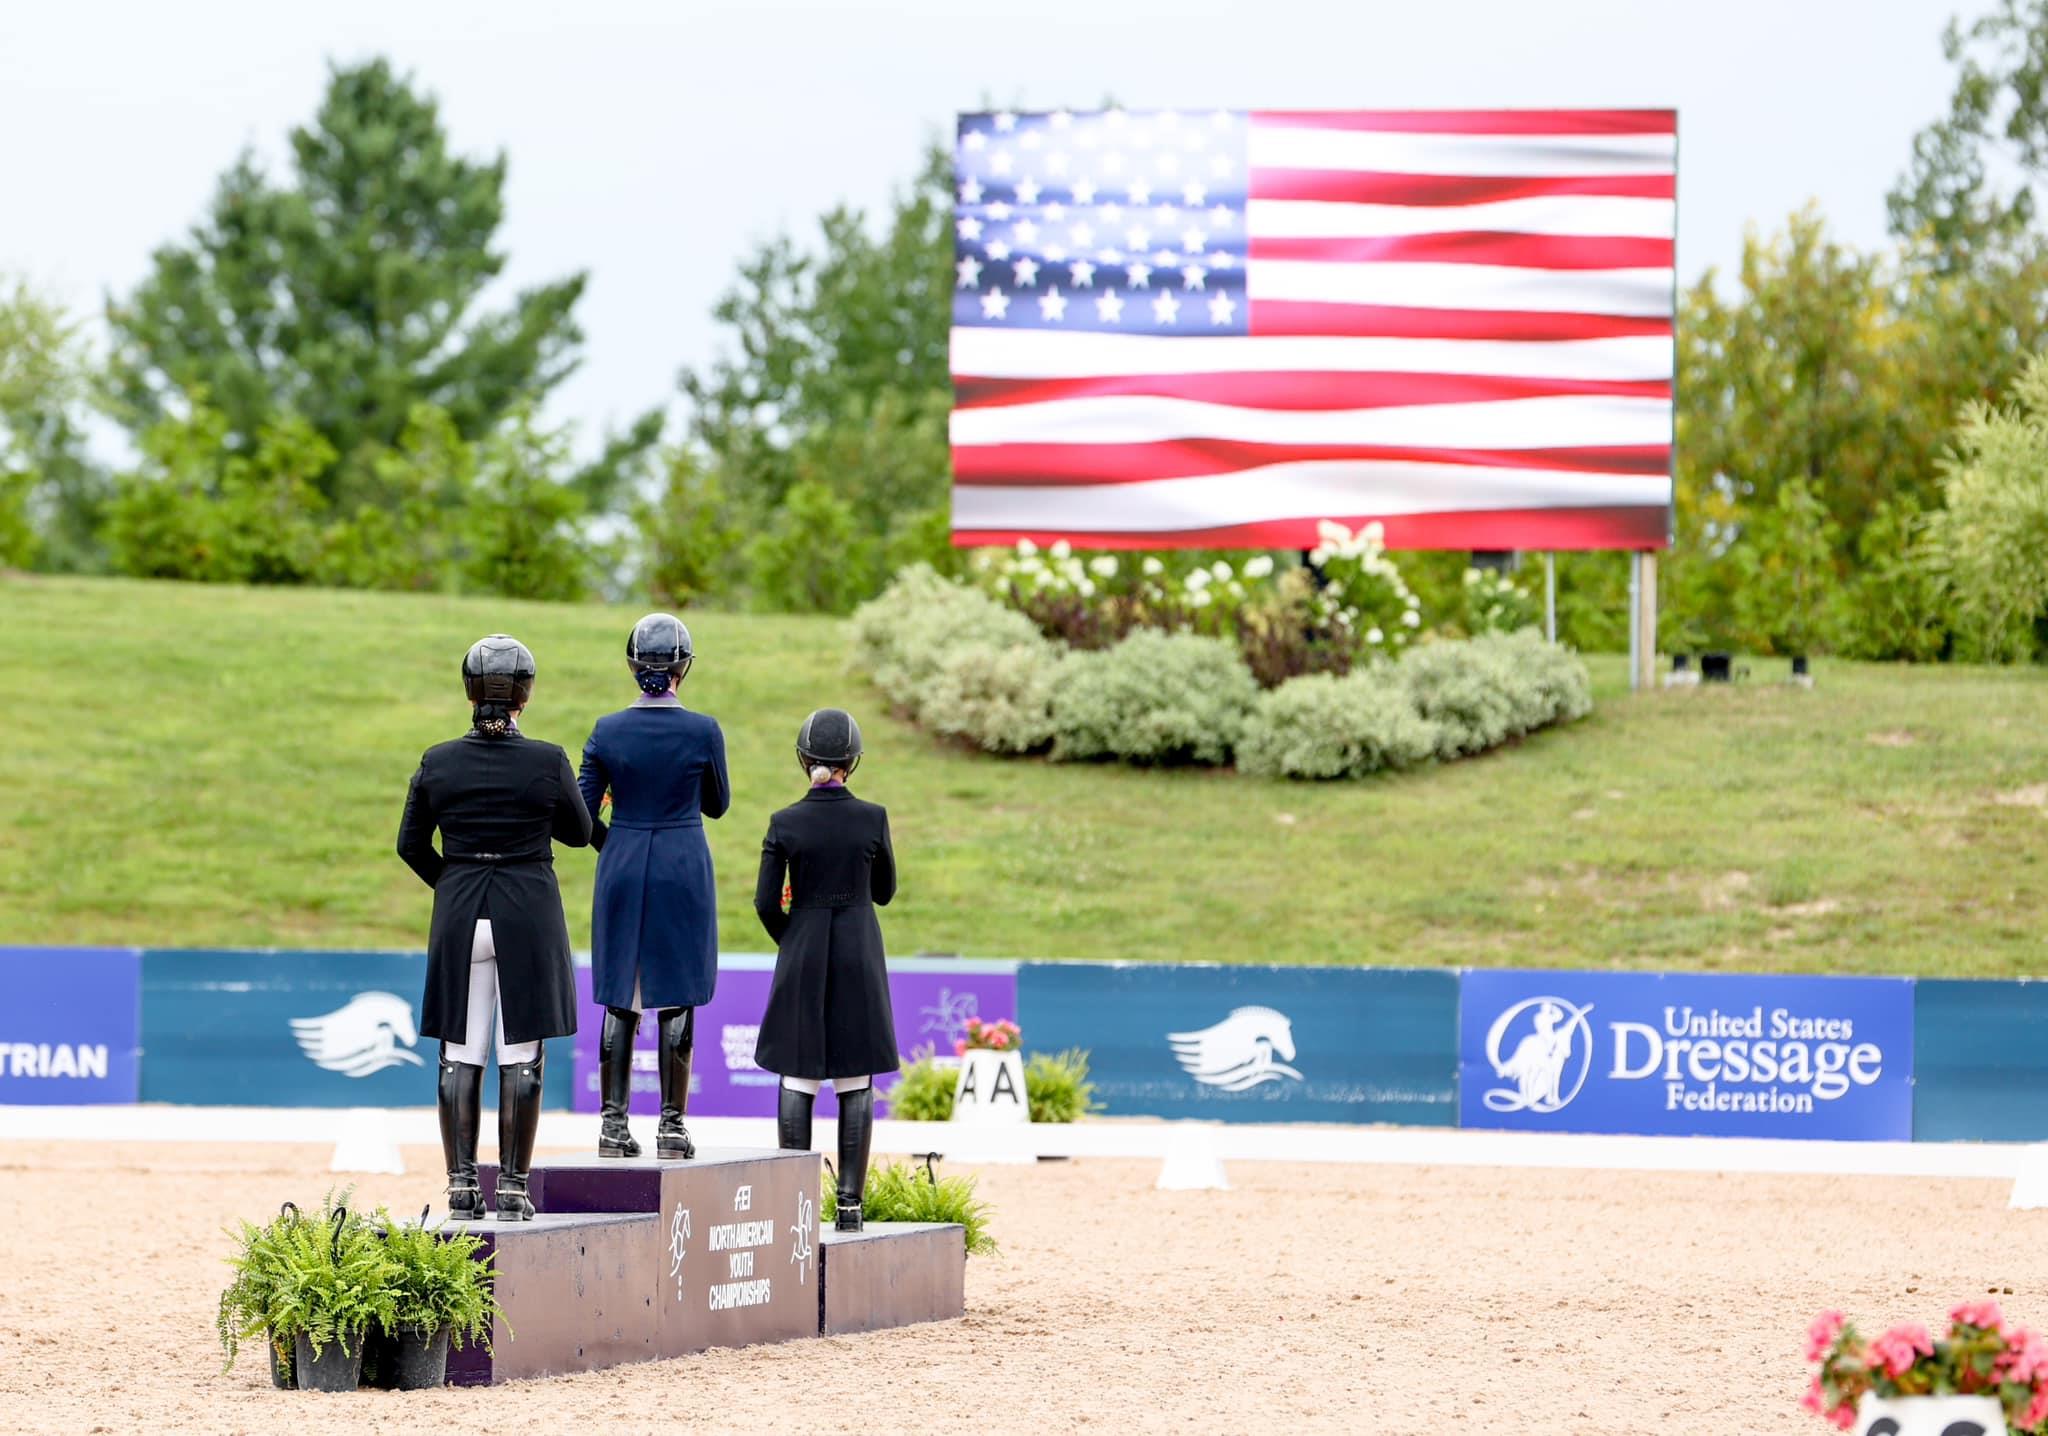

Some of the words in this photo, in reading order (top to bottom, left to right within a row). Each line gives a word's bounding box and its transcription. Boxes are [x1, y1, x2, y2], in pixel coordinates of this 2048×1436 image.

[1664, 1006, 1763, 1037] United
[1770, 1008, 1853, 1040] States
[1608, 1021, 1882, 1100] Dressage
[959, 1061, 976, 1104] A
[991, 1061, 1018, 1104] A
[1666, 1082, 1813, 1113] Federation
[709, 1225, 736, 1251] NORTH
[736, 1220, 774, 1248] AMERICAN
[730, 1252, 753, 1278] YOUTH
[709, 1279, 770, 1311] CHAMPIONSHIPS
